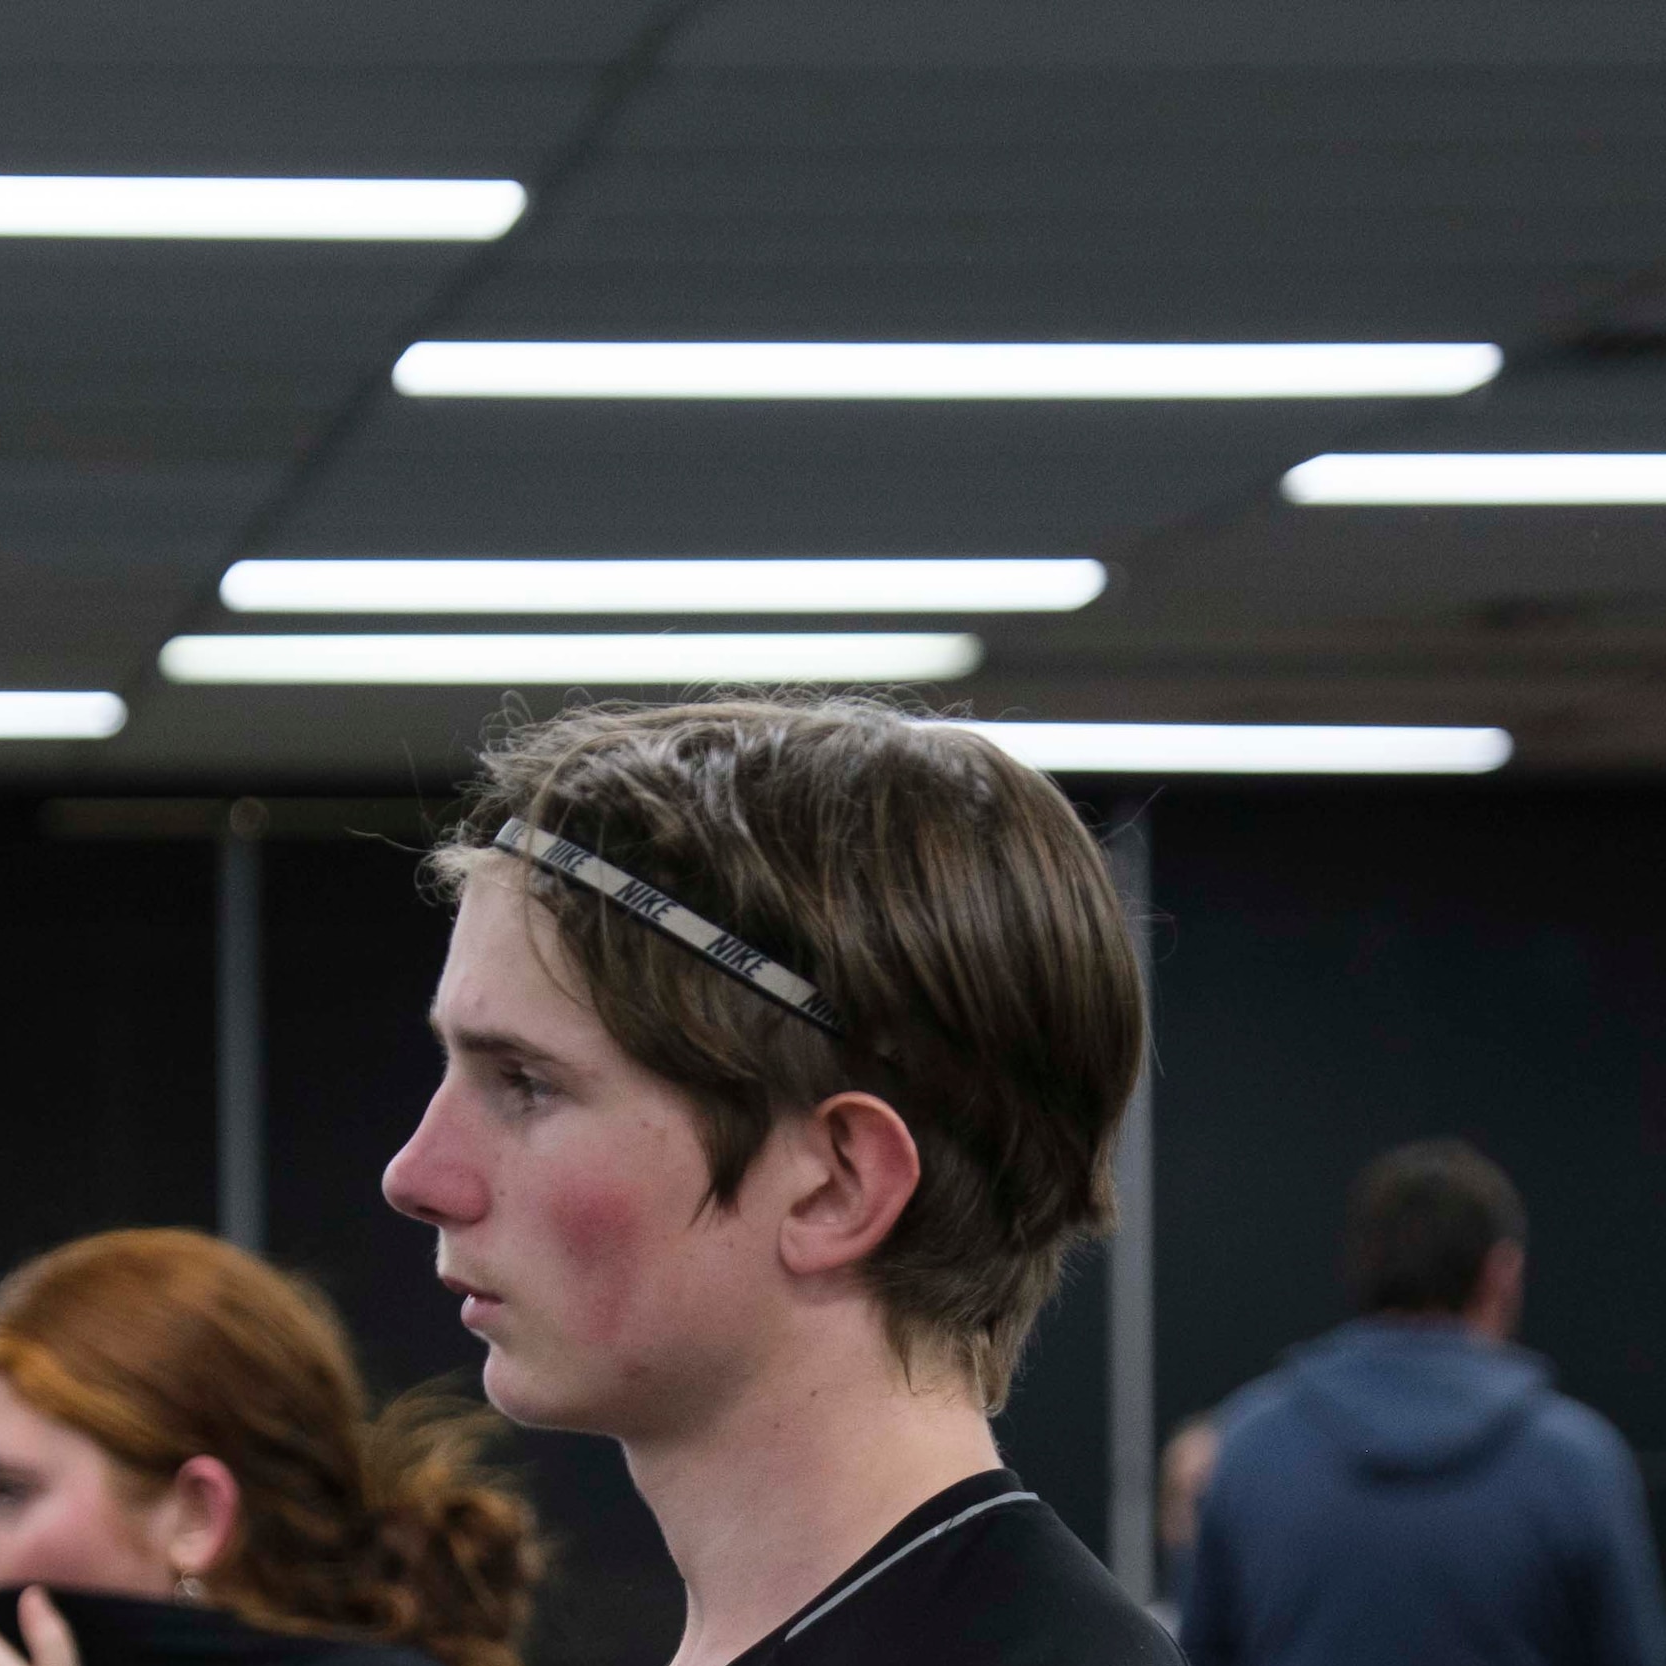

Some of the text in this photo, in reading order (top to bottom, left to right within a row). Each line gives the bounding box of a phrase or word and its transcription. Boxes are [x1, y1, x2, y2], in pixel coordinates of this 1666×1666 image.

[542, 838, 591, 873] NIKE
[614, 879, 680, 922] NIKE
[706, 933, 771, 978] NIKE
